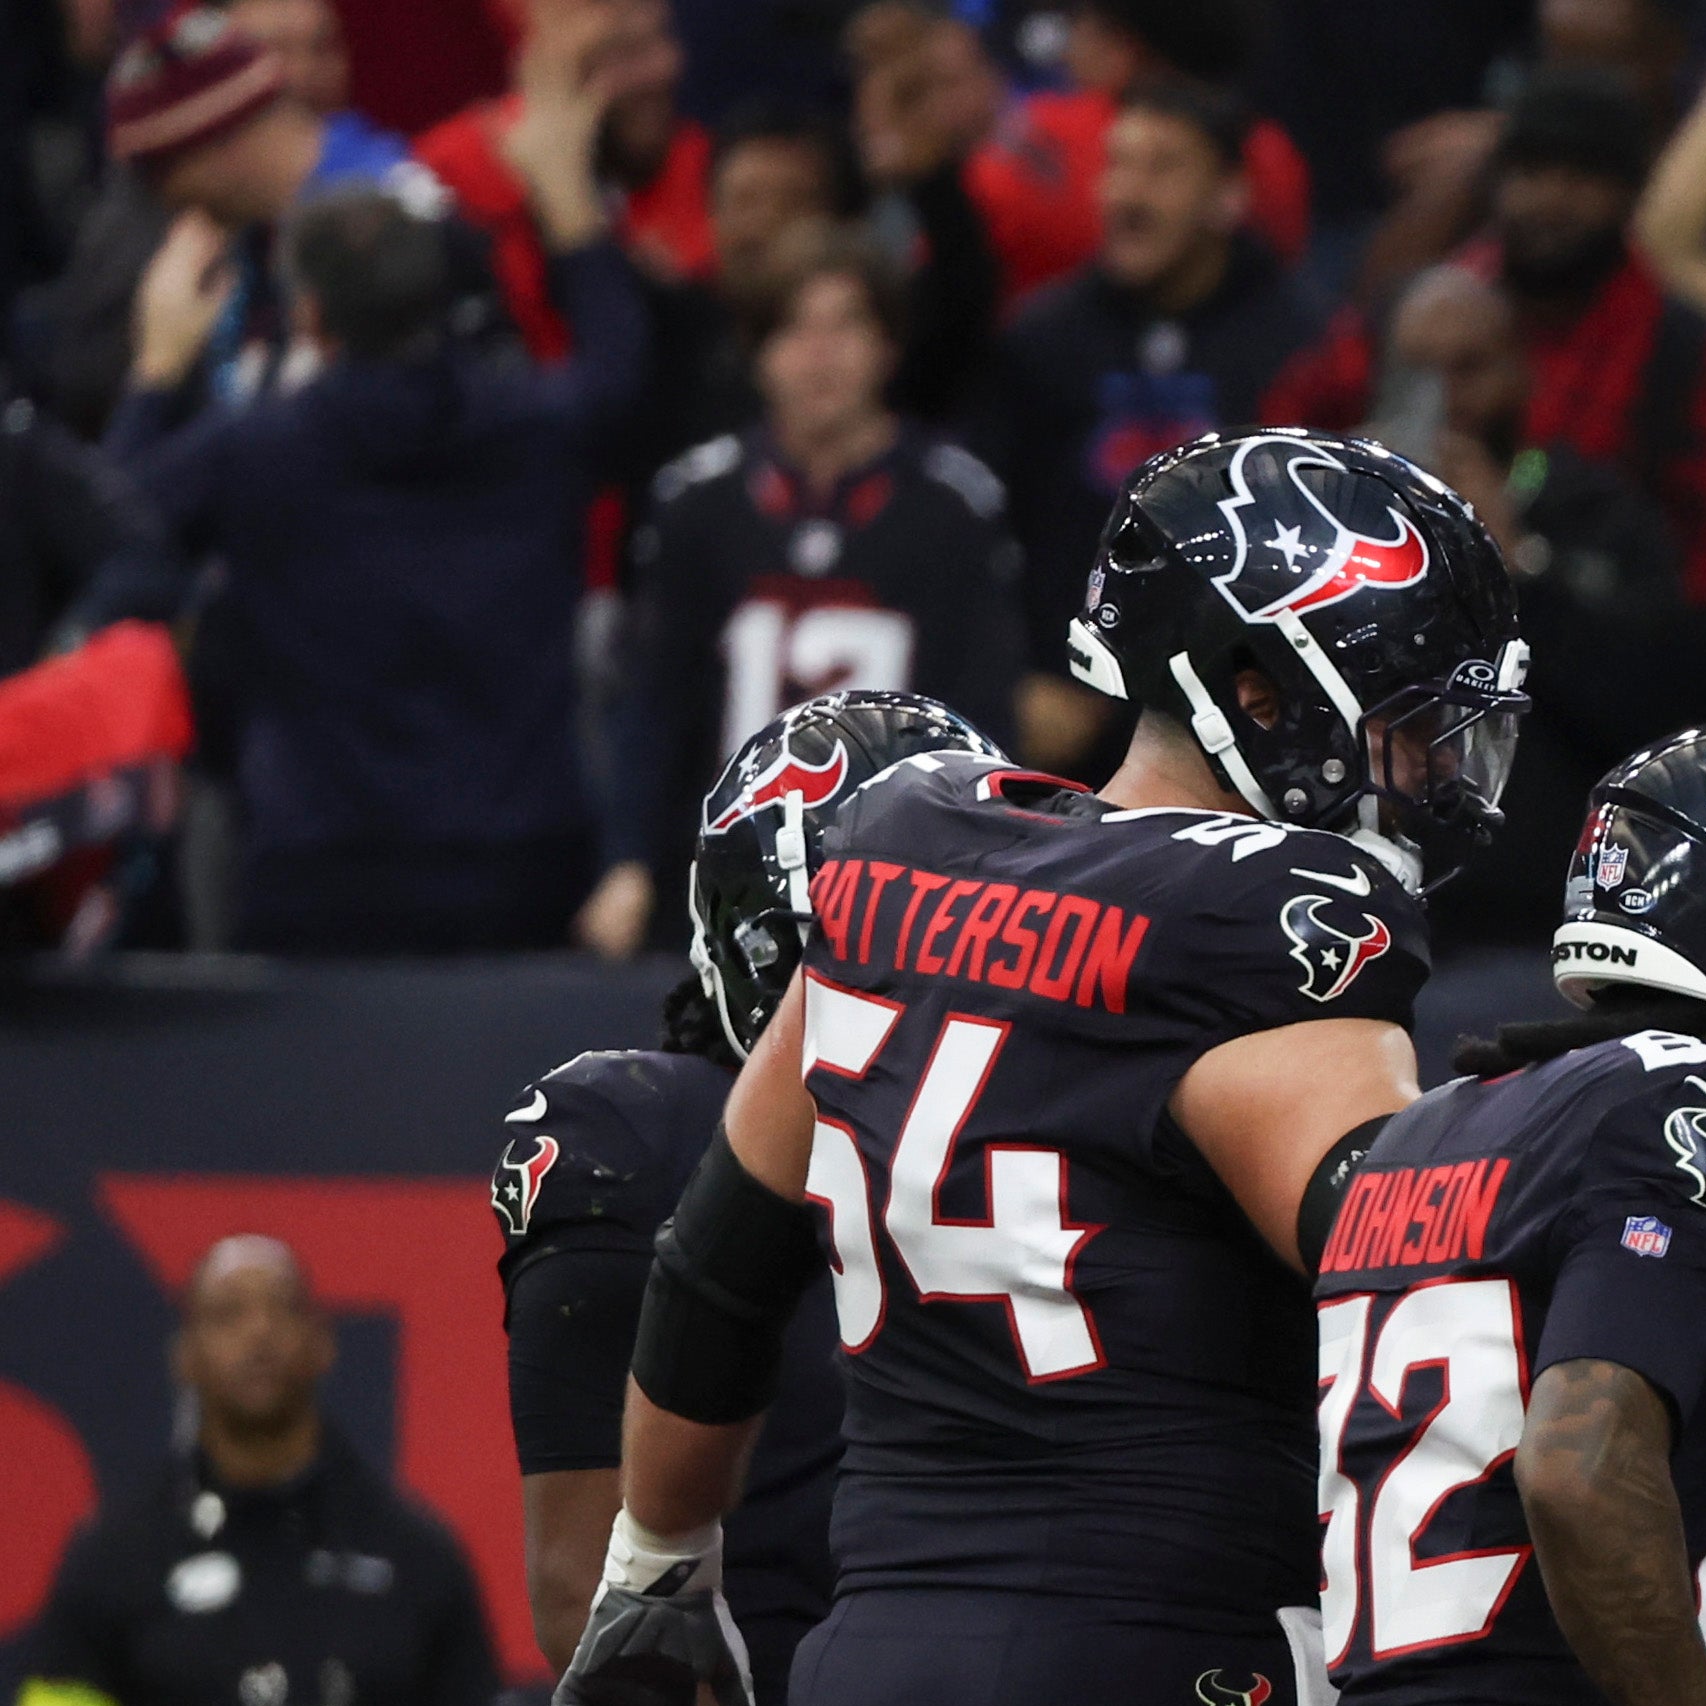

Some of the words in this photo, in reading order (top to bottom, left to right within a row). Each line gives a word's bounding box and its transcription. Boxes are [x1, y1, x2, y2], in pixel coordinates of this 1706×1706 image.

[1599, 864, 1621, 882] NFL
[801, 966, 1110, 1386] 54
[1317, 1156, 1512, 1275] JOHNSON
[1627, 1230, 1665, 1256] NFL
